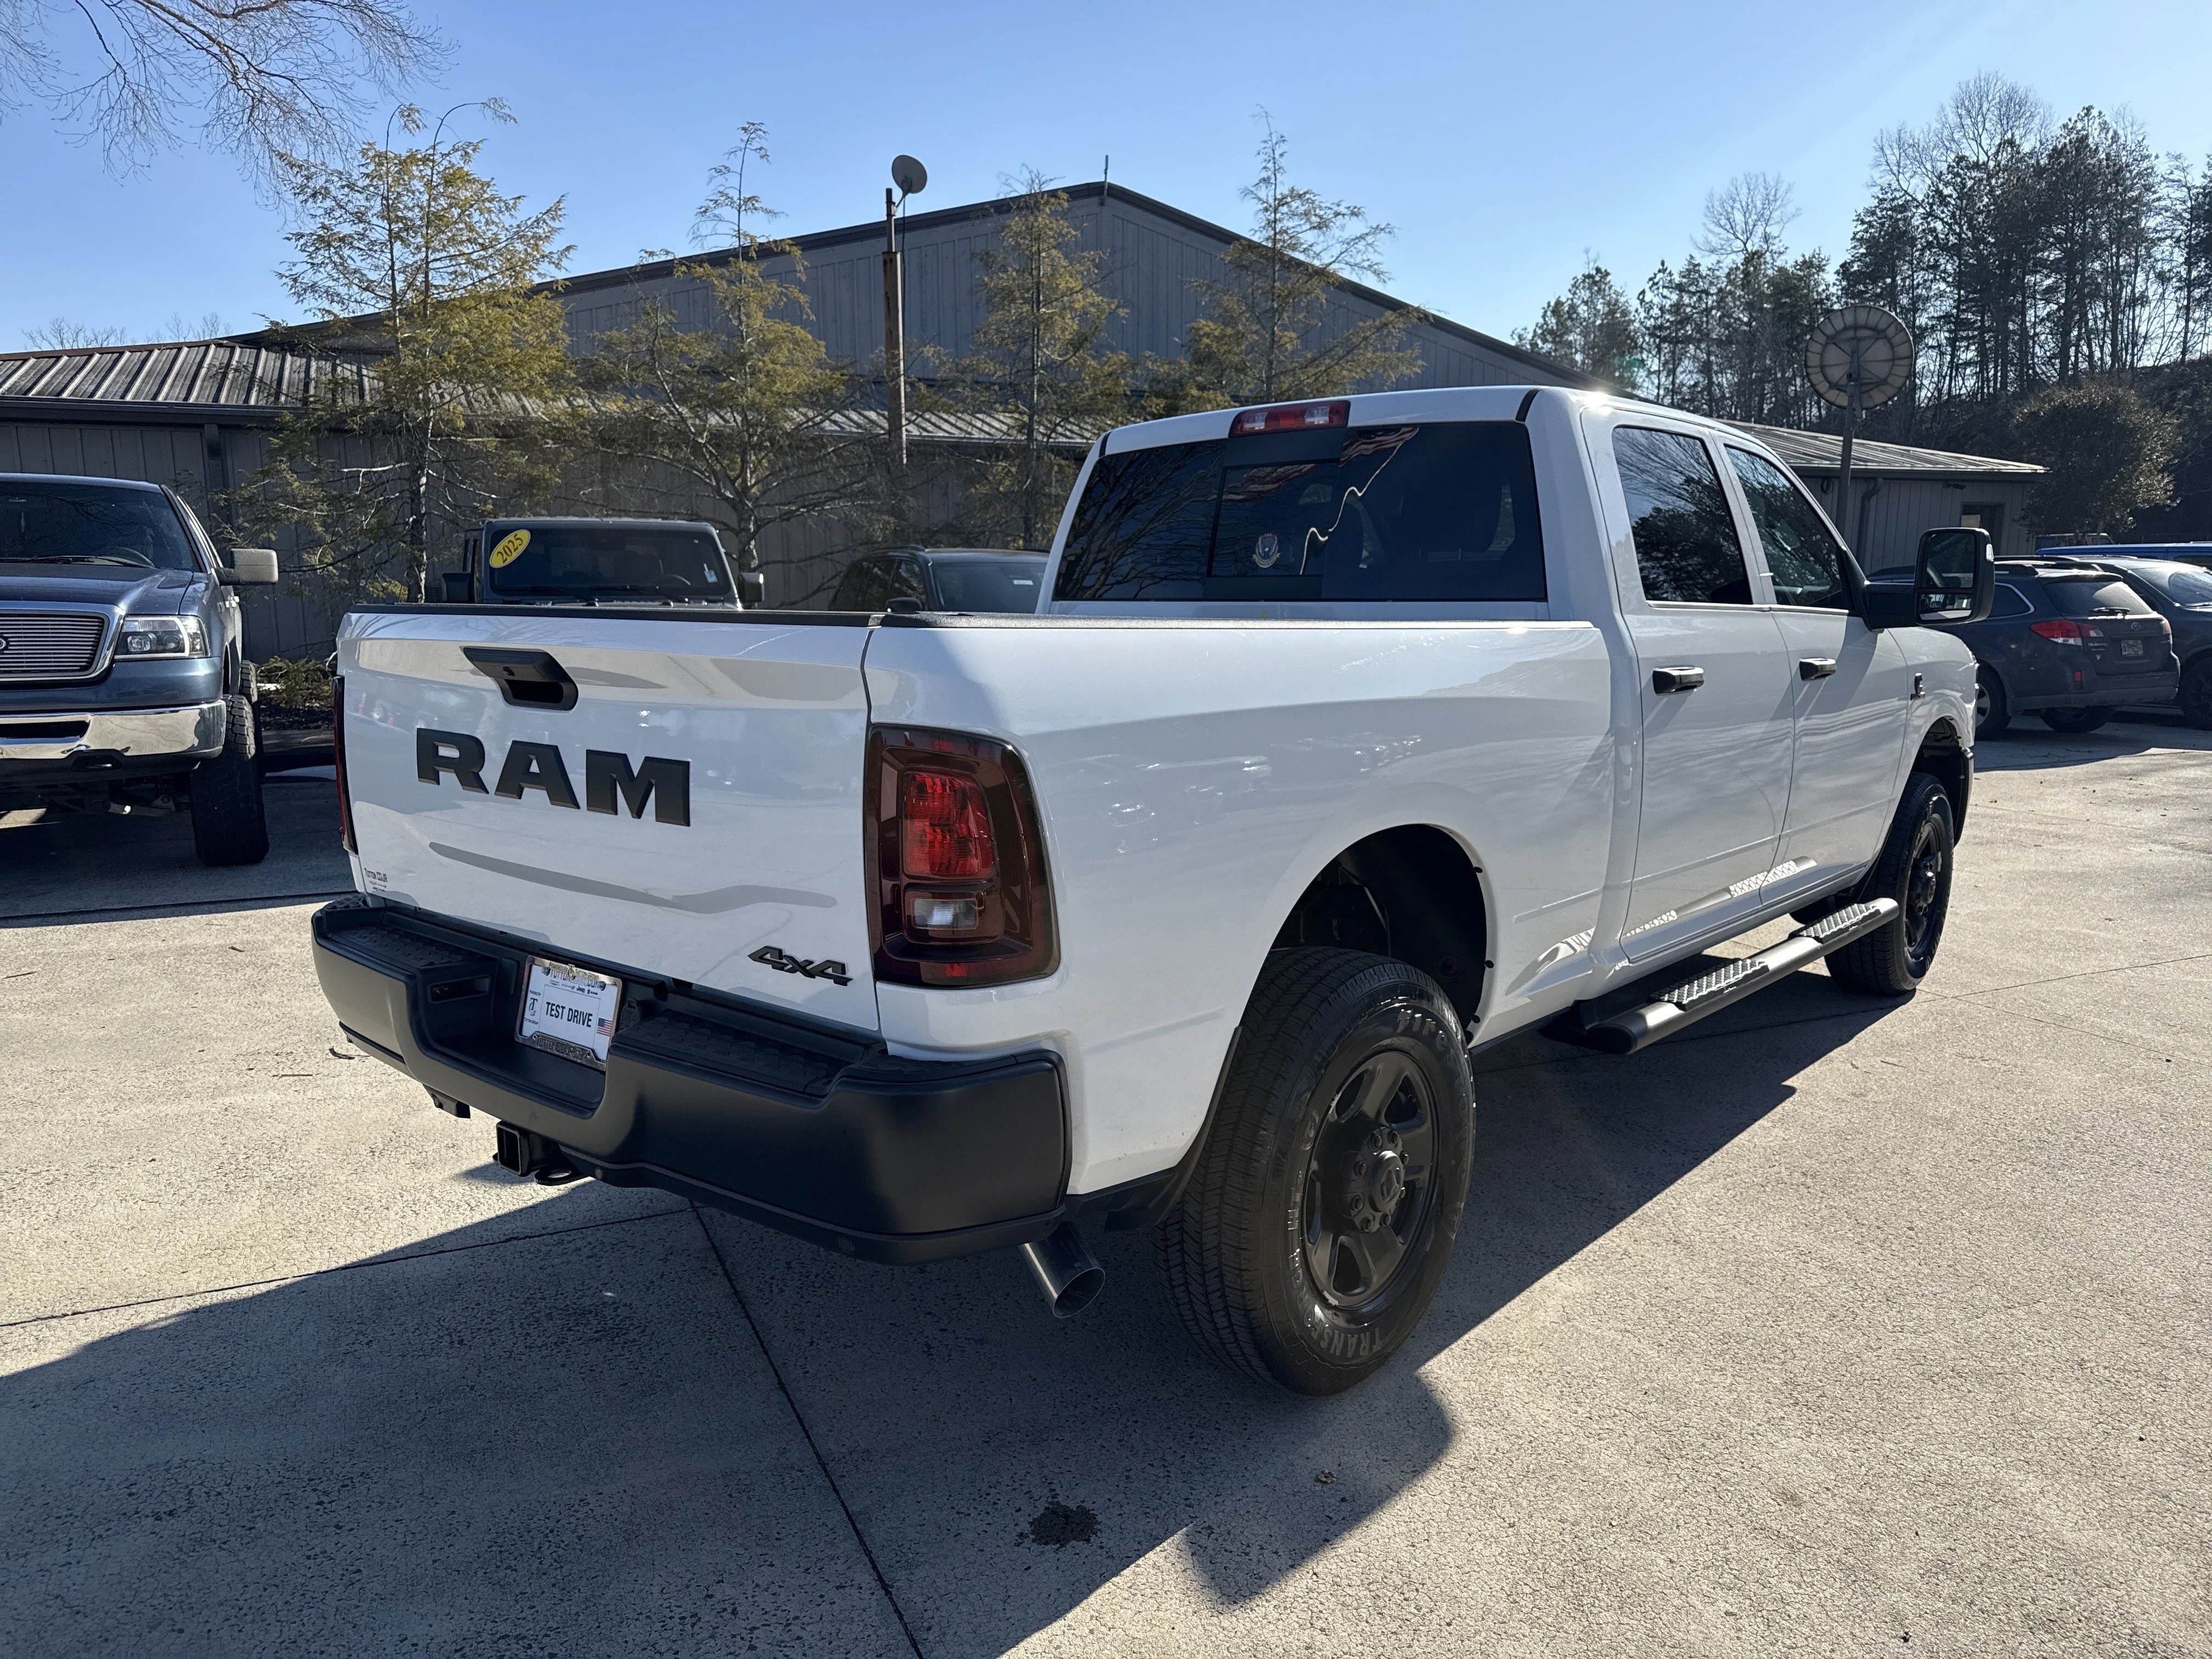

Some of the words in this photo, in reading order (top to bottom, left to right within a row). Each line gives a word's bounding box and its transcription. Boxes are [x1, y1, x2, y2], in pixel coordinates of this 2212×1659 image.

[497, 533, 523, 563] 2025
[416, 727, 691, 827] RAM
[546, 1001, 566, 1019] TEST
[567, 1008, 593, 1028] DRIVE
